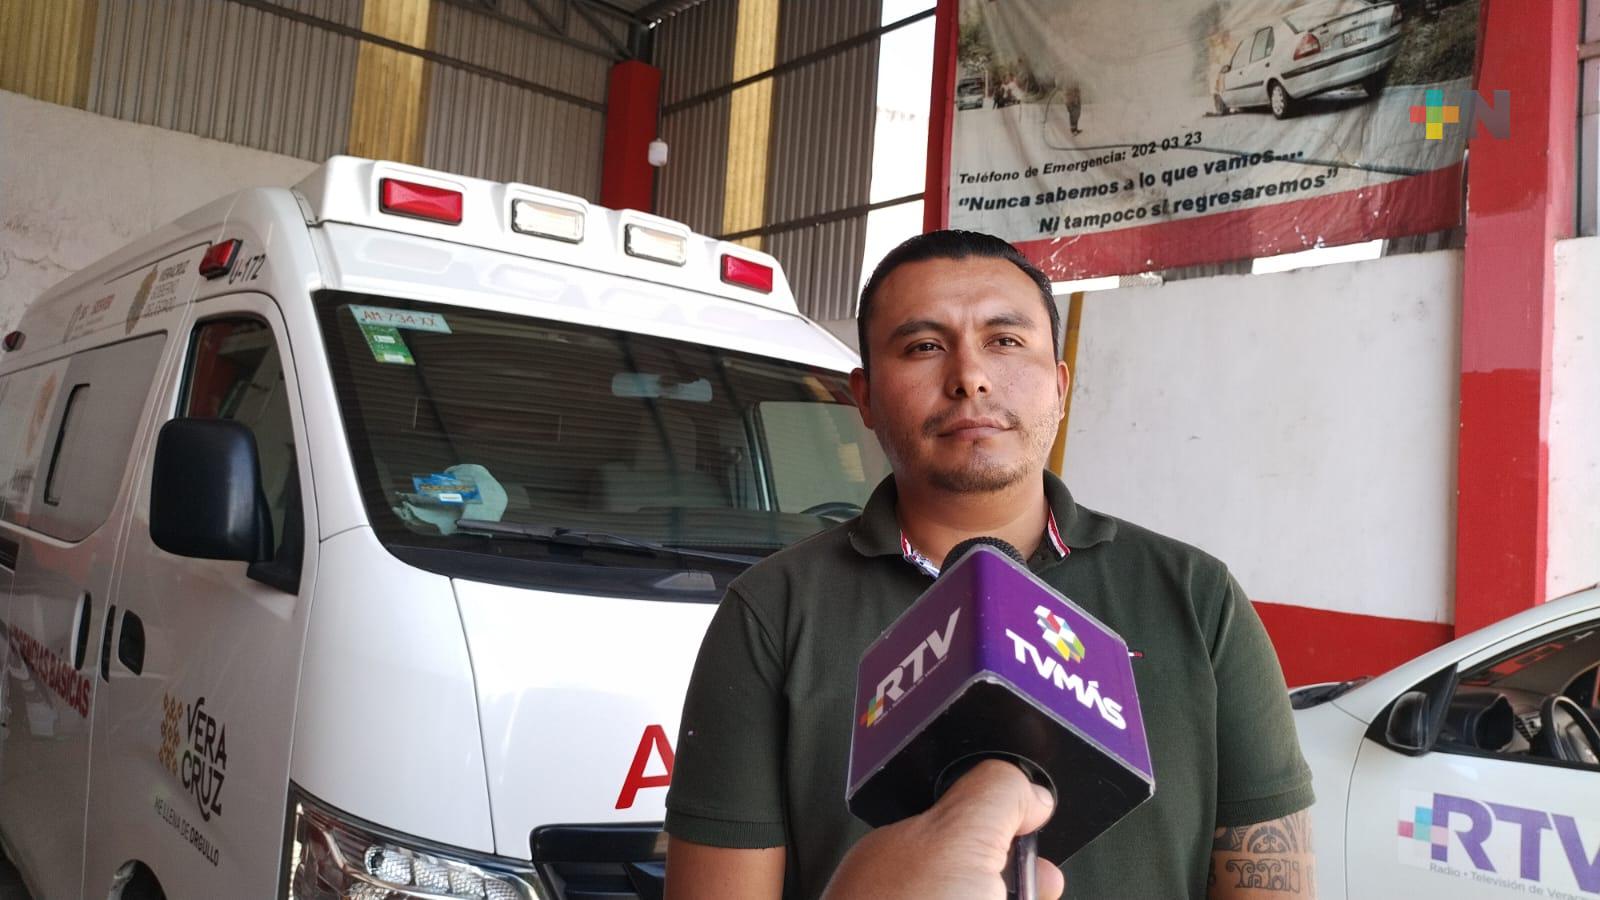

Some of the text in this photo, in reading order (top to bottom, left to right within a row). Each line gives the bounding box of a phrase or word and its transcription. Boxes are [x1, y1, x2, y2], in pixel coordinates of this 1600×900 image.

[959, 131, 1202, 184] Teléfono de Emergencia: 202 03 23
[1035, 180, 1119, 205] sabemos
[1123, 178, 1134, 191] a
[1139, 172, 1156, 188] lo
[1161, 164, 1198, 187] que
[1064, 207, 1147, 229] tampoco
[870, 606, 961, 721] RTV
[186, 696, 227, 770] VERA
[181, 750, 225, 822] CRUZ
[163, 801, 180, 829] LLENA
[180, 819, 190, 840] DE
[189, 827, 220, 867] ORGULLO
[1431, 792, 1600, 895] RTV
[1429, 862, 1461, 878] Radio
[1471, 871, 1526, 894] Televisión
[1528, 883, 1544, 896] de
